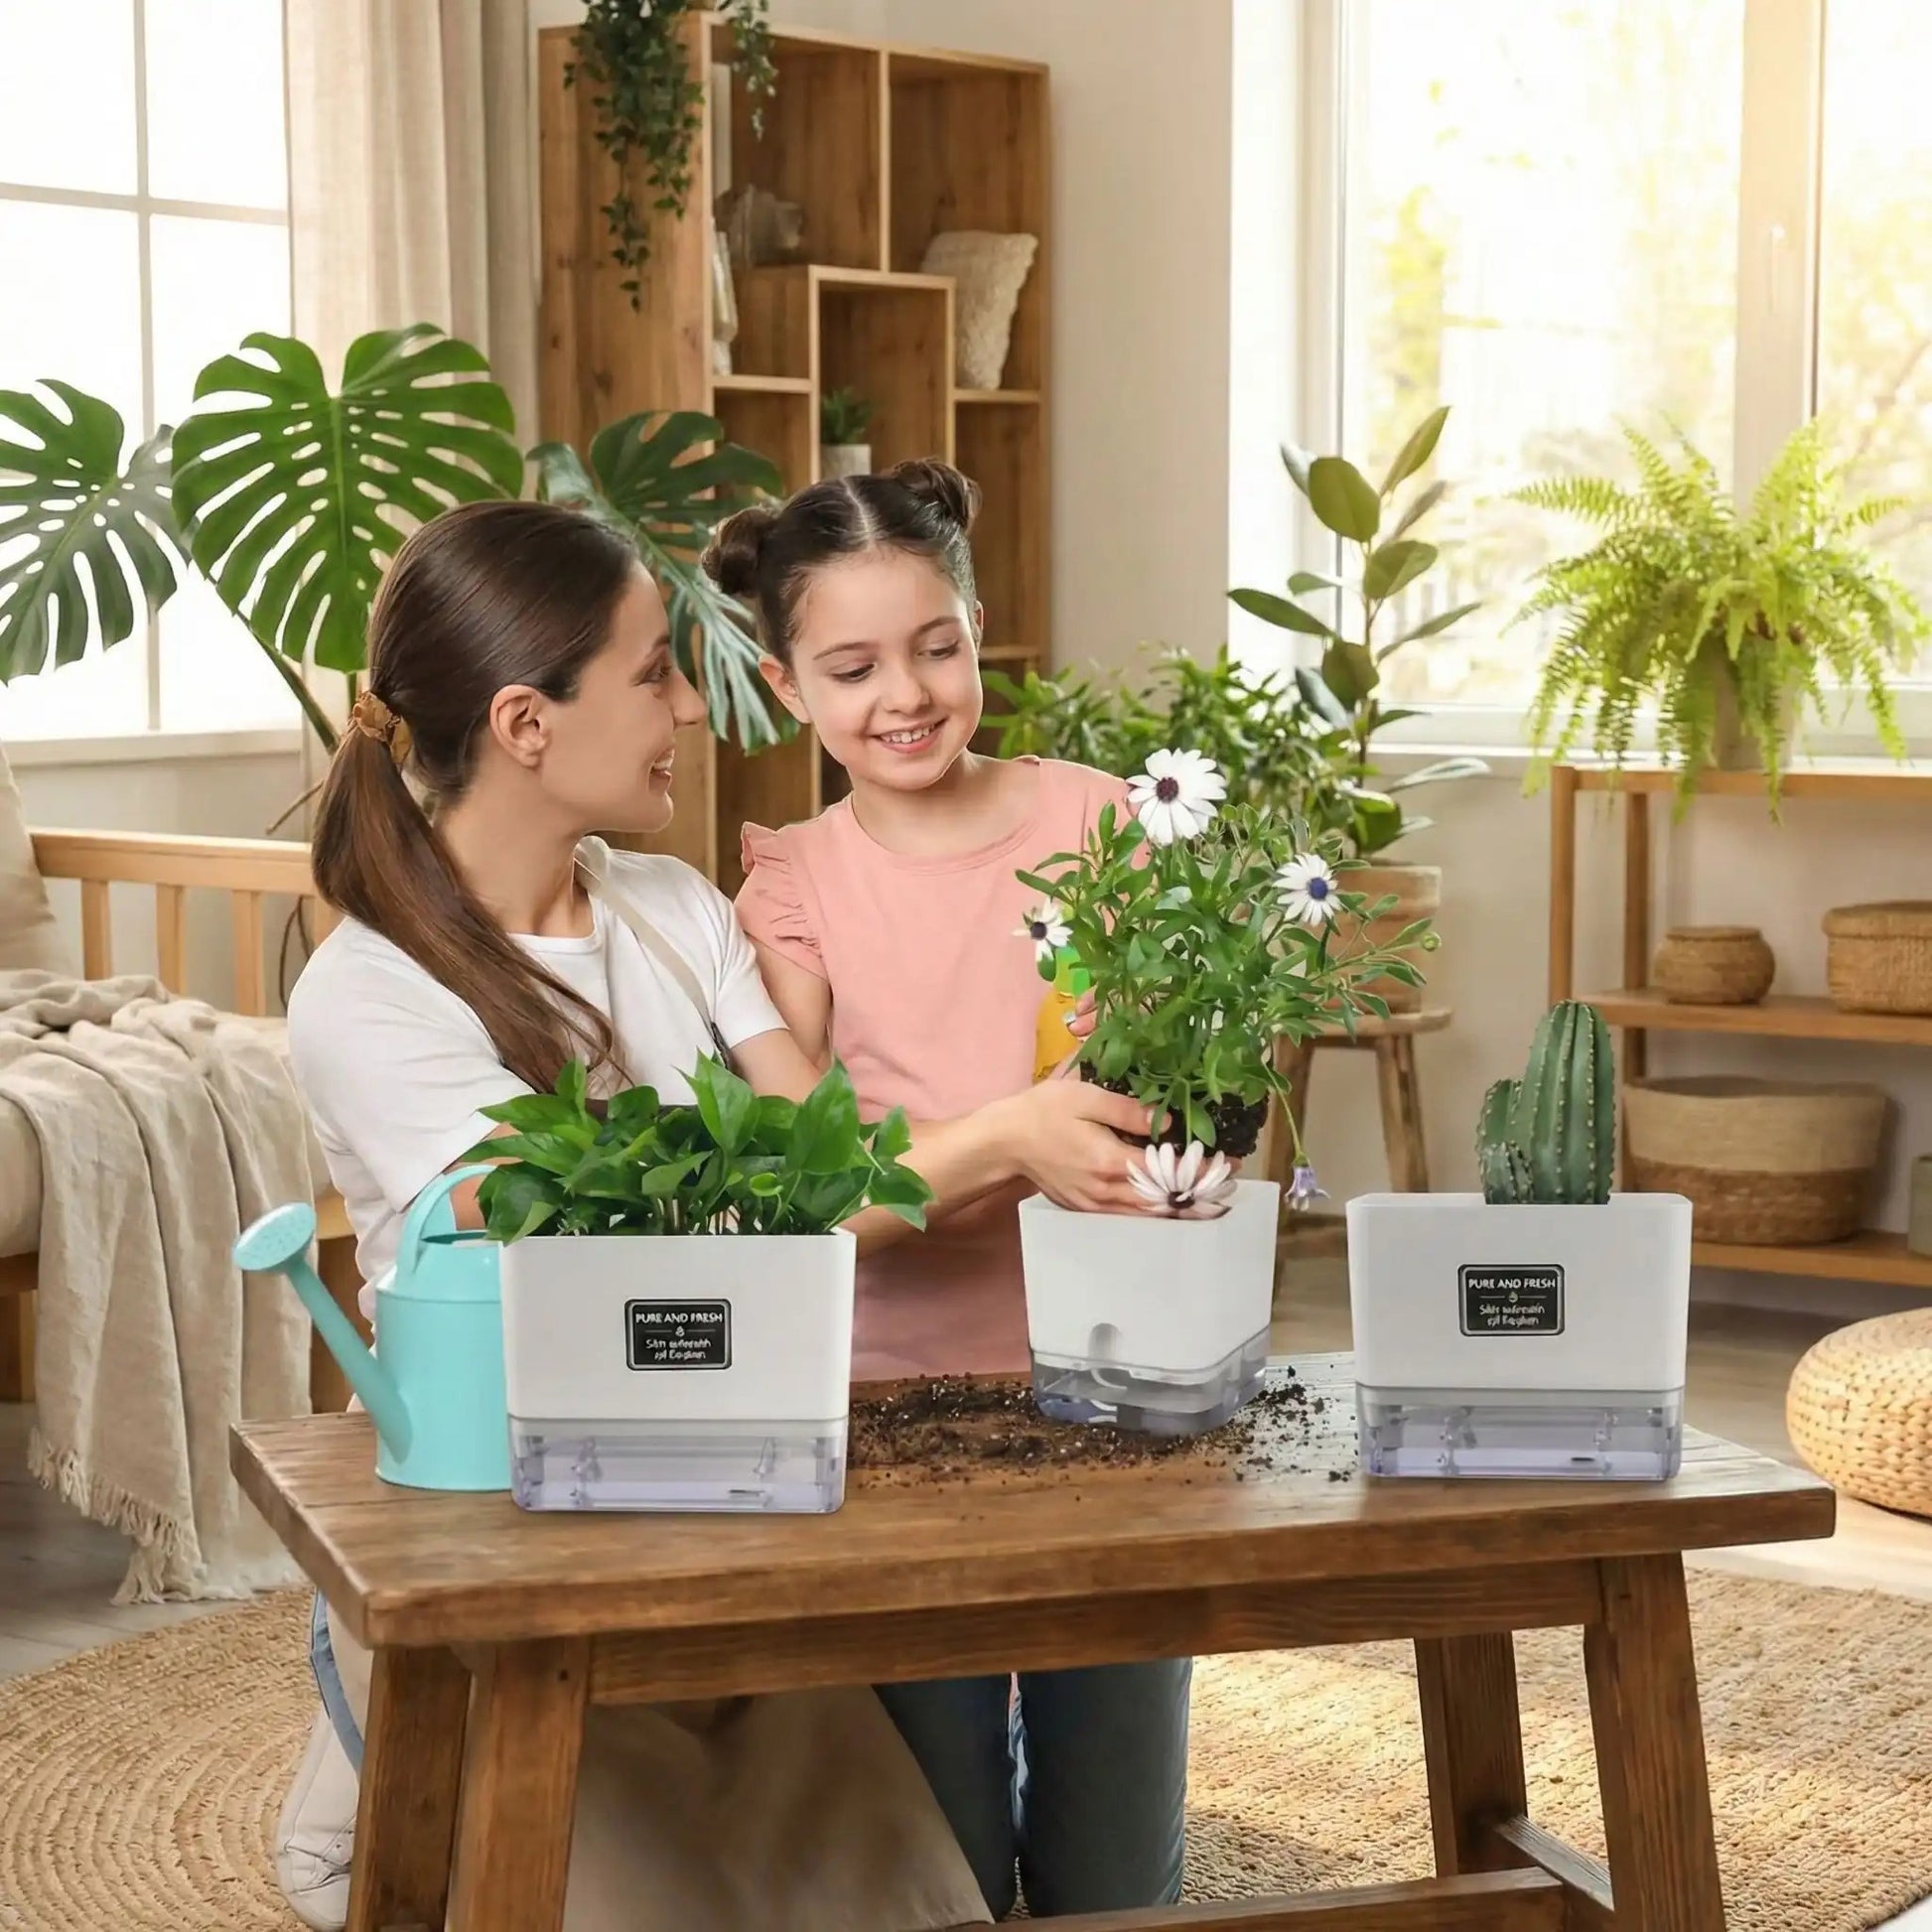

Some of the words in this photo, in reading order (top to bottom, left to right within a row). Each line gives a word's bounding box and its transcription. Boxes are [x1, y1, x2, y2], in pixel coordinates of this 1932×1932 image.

[1468, 1279, 1495, 1289] PURE
[1497, 1279, 1522, 1289] AND
[1523, 1278, 1556, 1289] FRESH
[635, 1312, 662, 1323] PURE
[664, 1312, 689, 1322] AND
